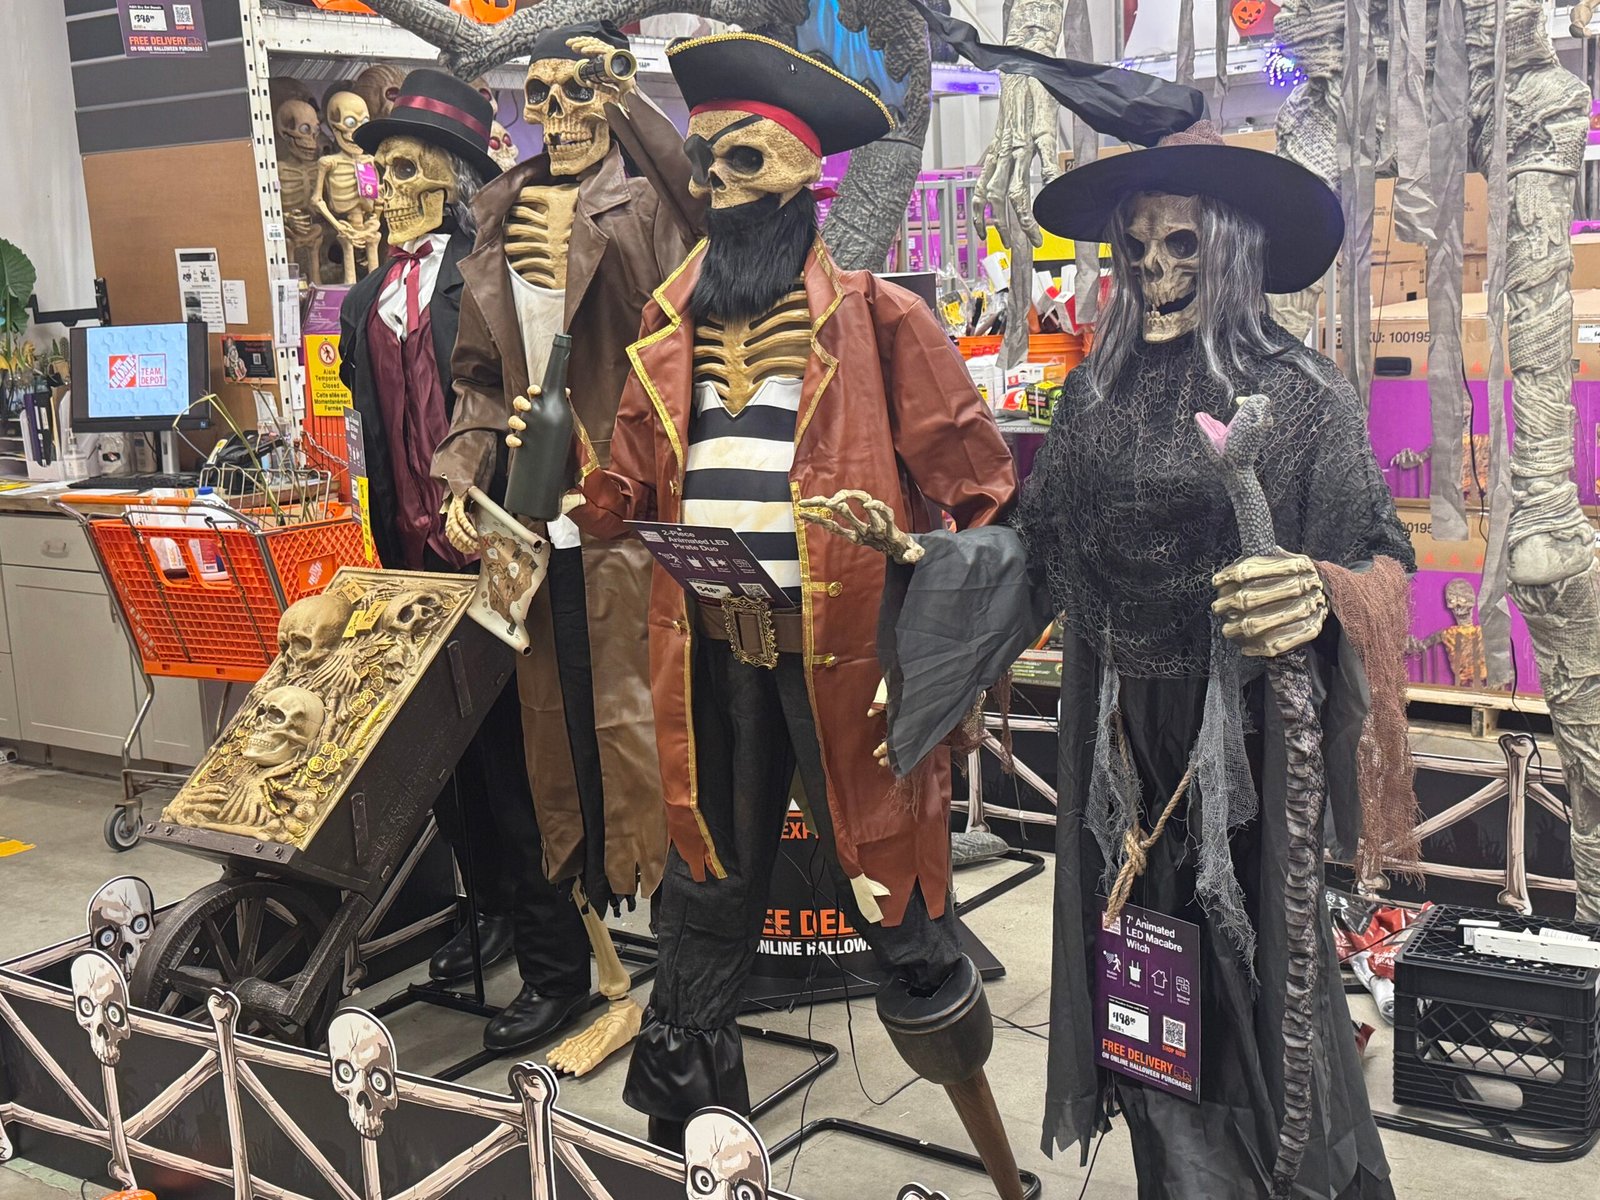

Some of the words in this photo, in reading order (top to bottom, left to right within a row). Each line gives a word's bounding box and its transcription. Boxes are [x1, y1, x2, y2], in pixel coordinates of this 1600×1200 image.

[129, 36, 149, 45] FREE
[150, 36, 187, 45] DELIVERY
[141, 367, 161, 375] TEAM
[141, 376, 163, 385] DEPOT
[661, 529, 696, 538] 2-Piece
[668, 536, 710, 546] Animated
[672, 543, 700, 551] Pirate
[800, 909, 857, 935] DEL
[1135, 919, 1176, 939] Animated
[756, 940, 802, 956] NLINE
[806, 938, 872, 956] HALLOW
[1126, 927, 1144, 940] LED
[1145, 933, 1183, 953] Macabre
[1126, 938, 1151, 954] Witch
[1102, 1038, 1126, 1057] FREE
[1128, 1047, 1174, 1075] DELIVERY
[1101, 1051, 1110, 1060] ON
[1110, 1053, 1129, 1067] ONLINE
[1129, 1061, 1160, 1079] HALLOWEEN
[1161, 1073, 1192, 1091] PURCHASES
